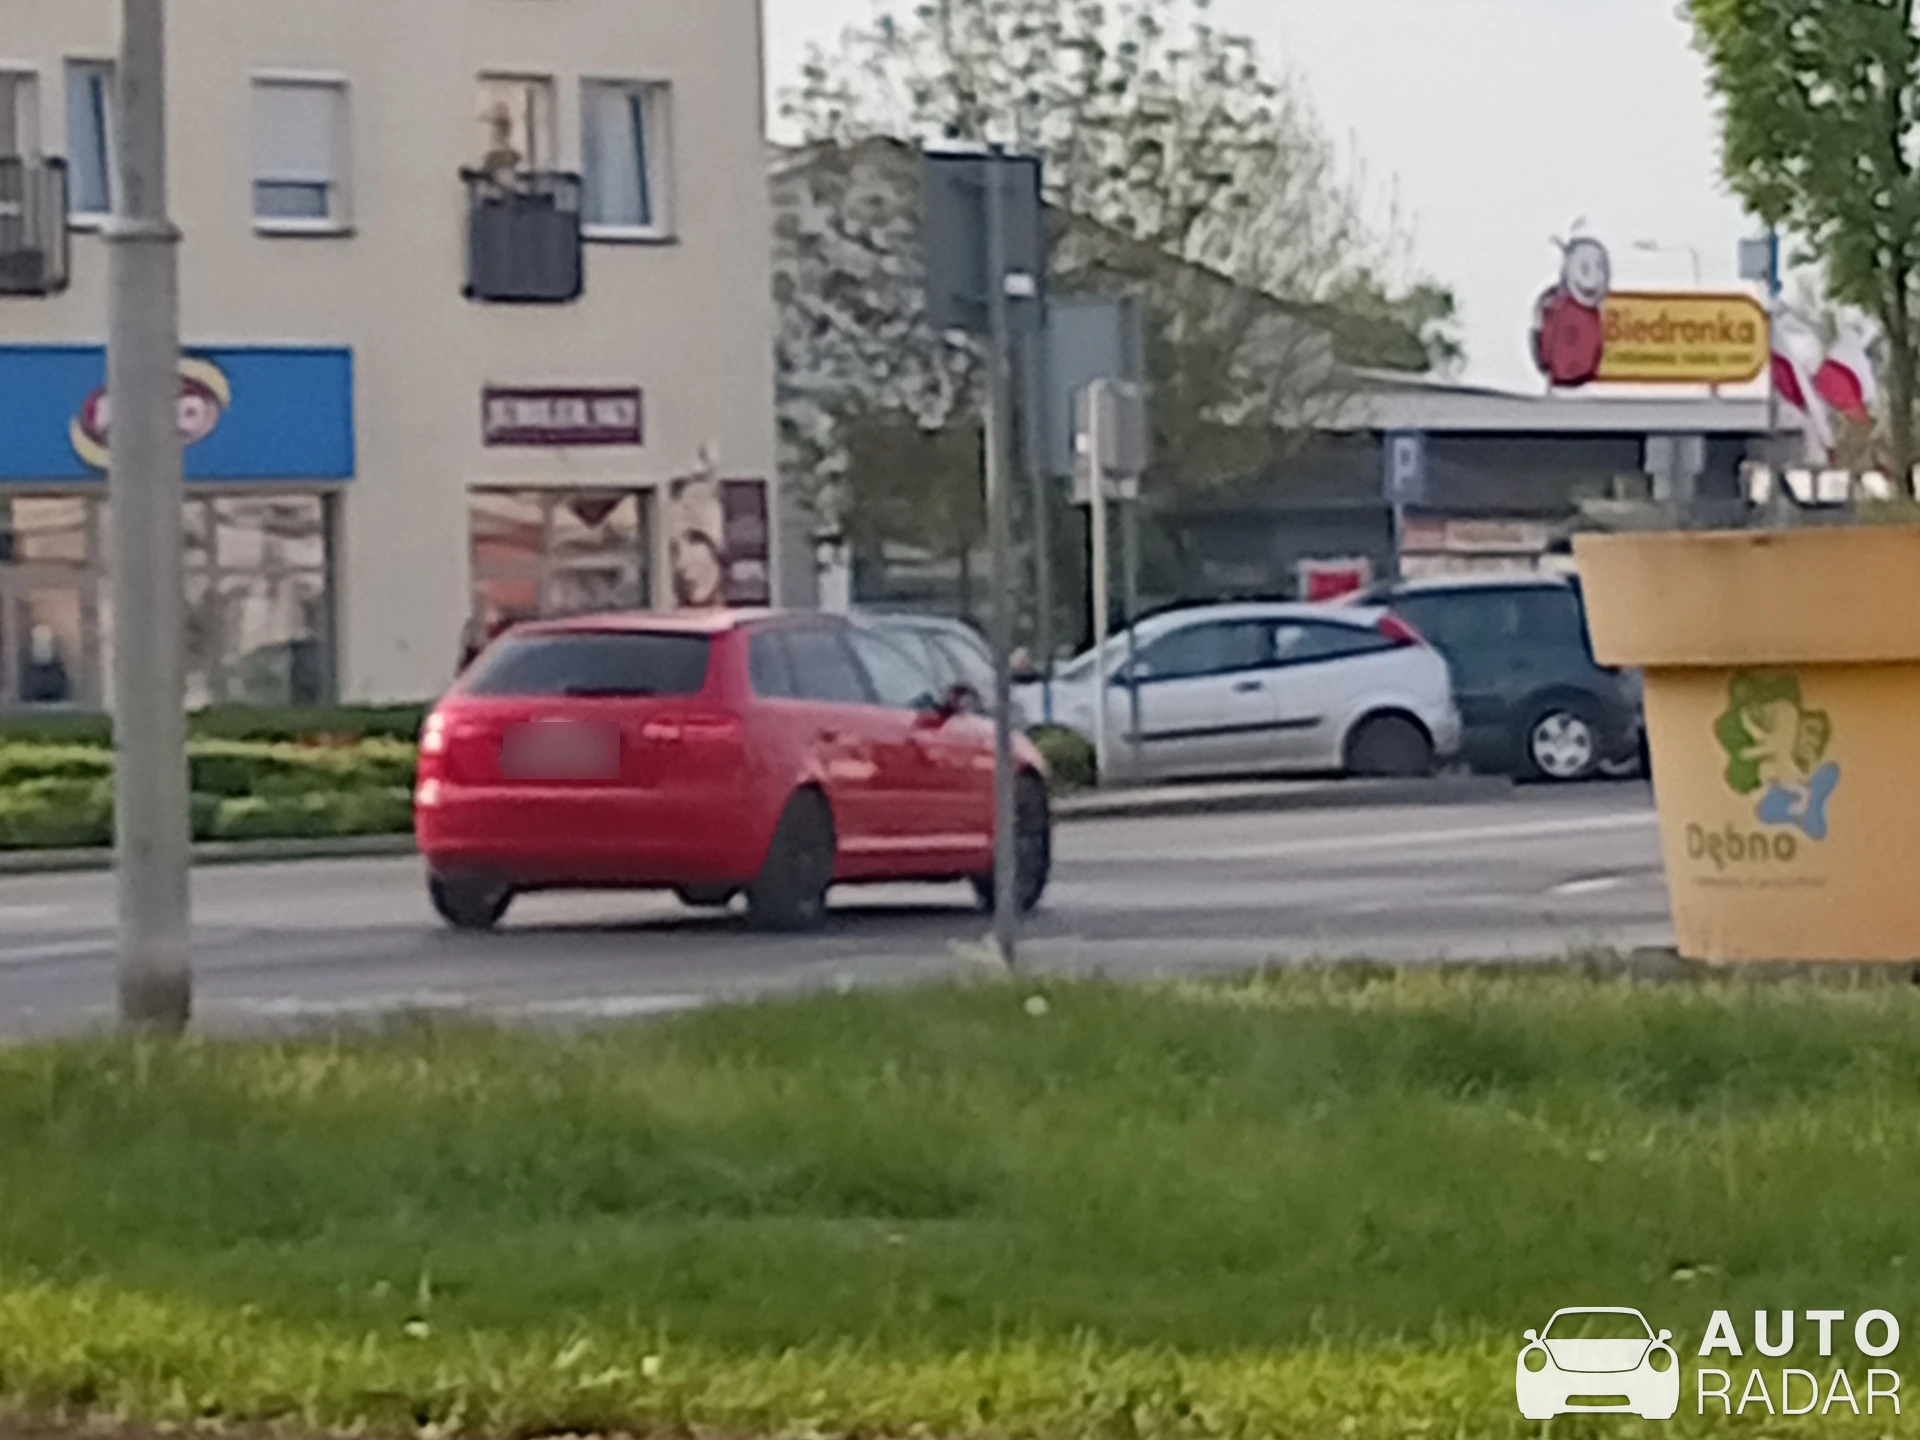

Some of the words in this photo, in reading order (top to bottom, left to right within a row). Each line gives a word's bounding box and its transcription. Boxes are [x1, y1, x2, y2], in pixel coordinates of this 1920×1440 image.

[1604, 309, 1755, 344] Biedronka
[1393, 438, 1418, 491] P
[1686, 822, 1797, 871] Dębno
